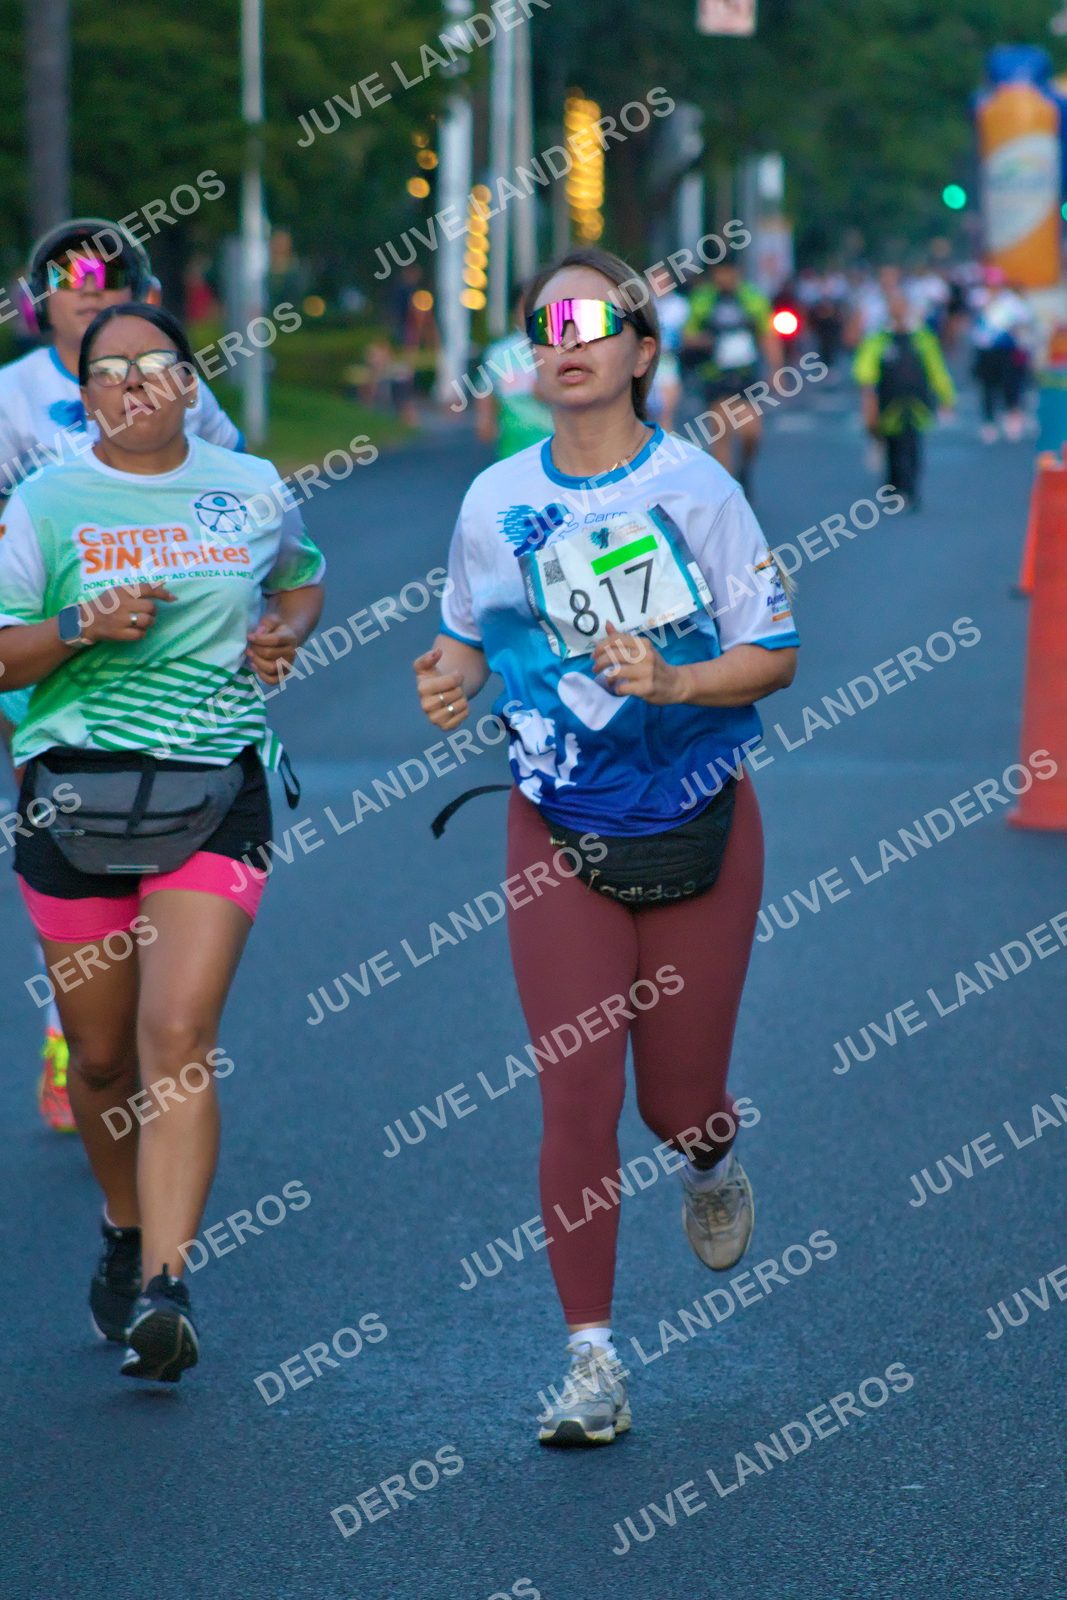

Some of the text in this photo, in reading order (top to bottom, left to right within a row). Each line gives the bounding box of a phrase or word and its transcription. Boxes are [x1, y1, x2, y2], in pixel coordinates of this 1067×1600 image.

[584, 511, 629, 524] Carr
[79, 526, 189, 547] Carrera
[84, 544, 250, 575] SIN límites
[188, 569, 221, 579] CRUZA
[223, 569, 234, 577] LA
[569, 557, 654, 636] 817
